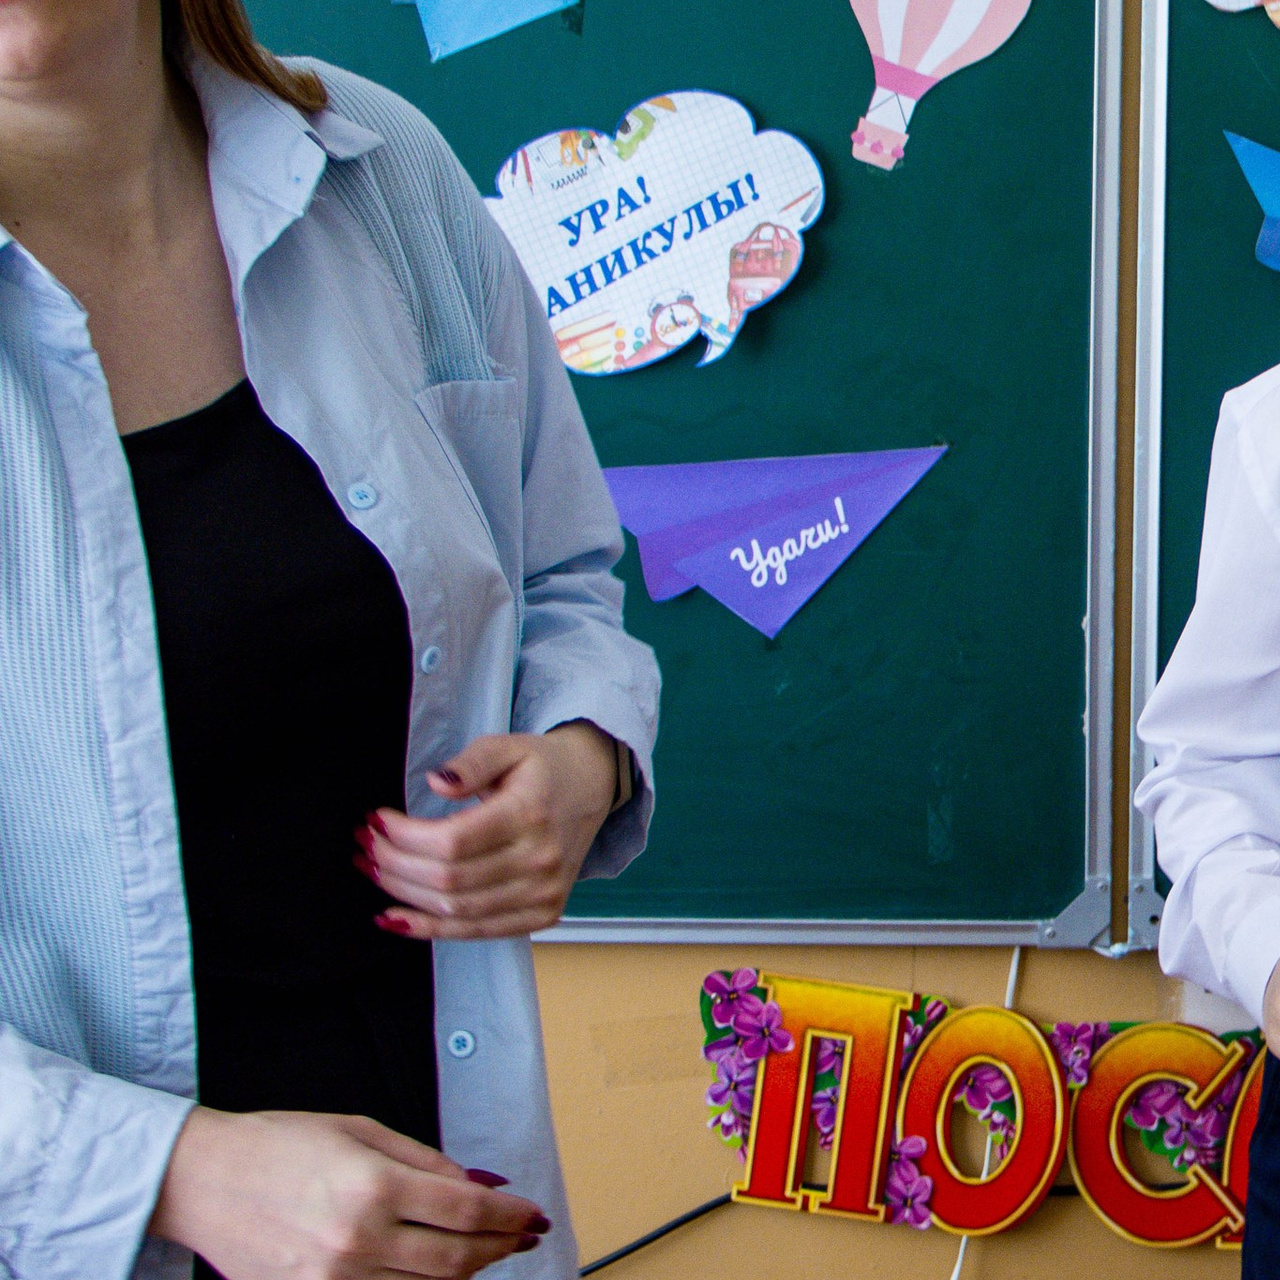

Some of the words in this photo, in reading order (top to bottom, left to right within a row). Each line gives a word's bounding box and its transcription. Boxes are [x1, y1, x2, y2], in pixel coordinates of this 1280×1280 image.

[547, 172, 763, 319] АНИКУЛЫ!
[557, 175, 654, 248] УРА!
[729, 495, 852, 589] Удачи!
